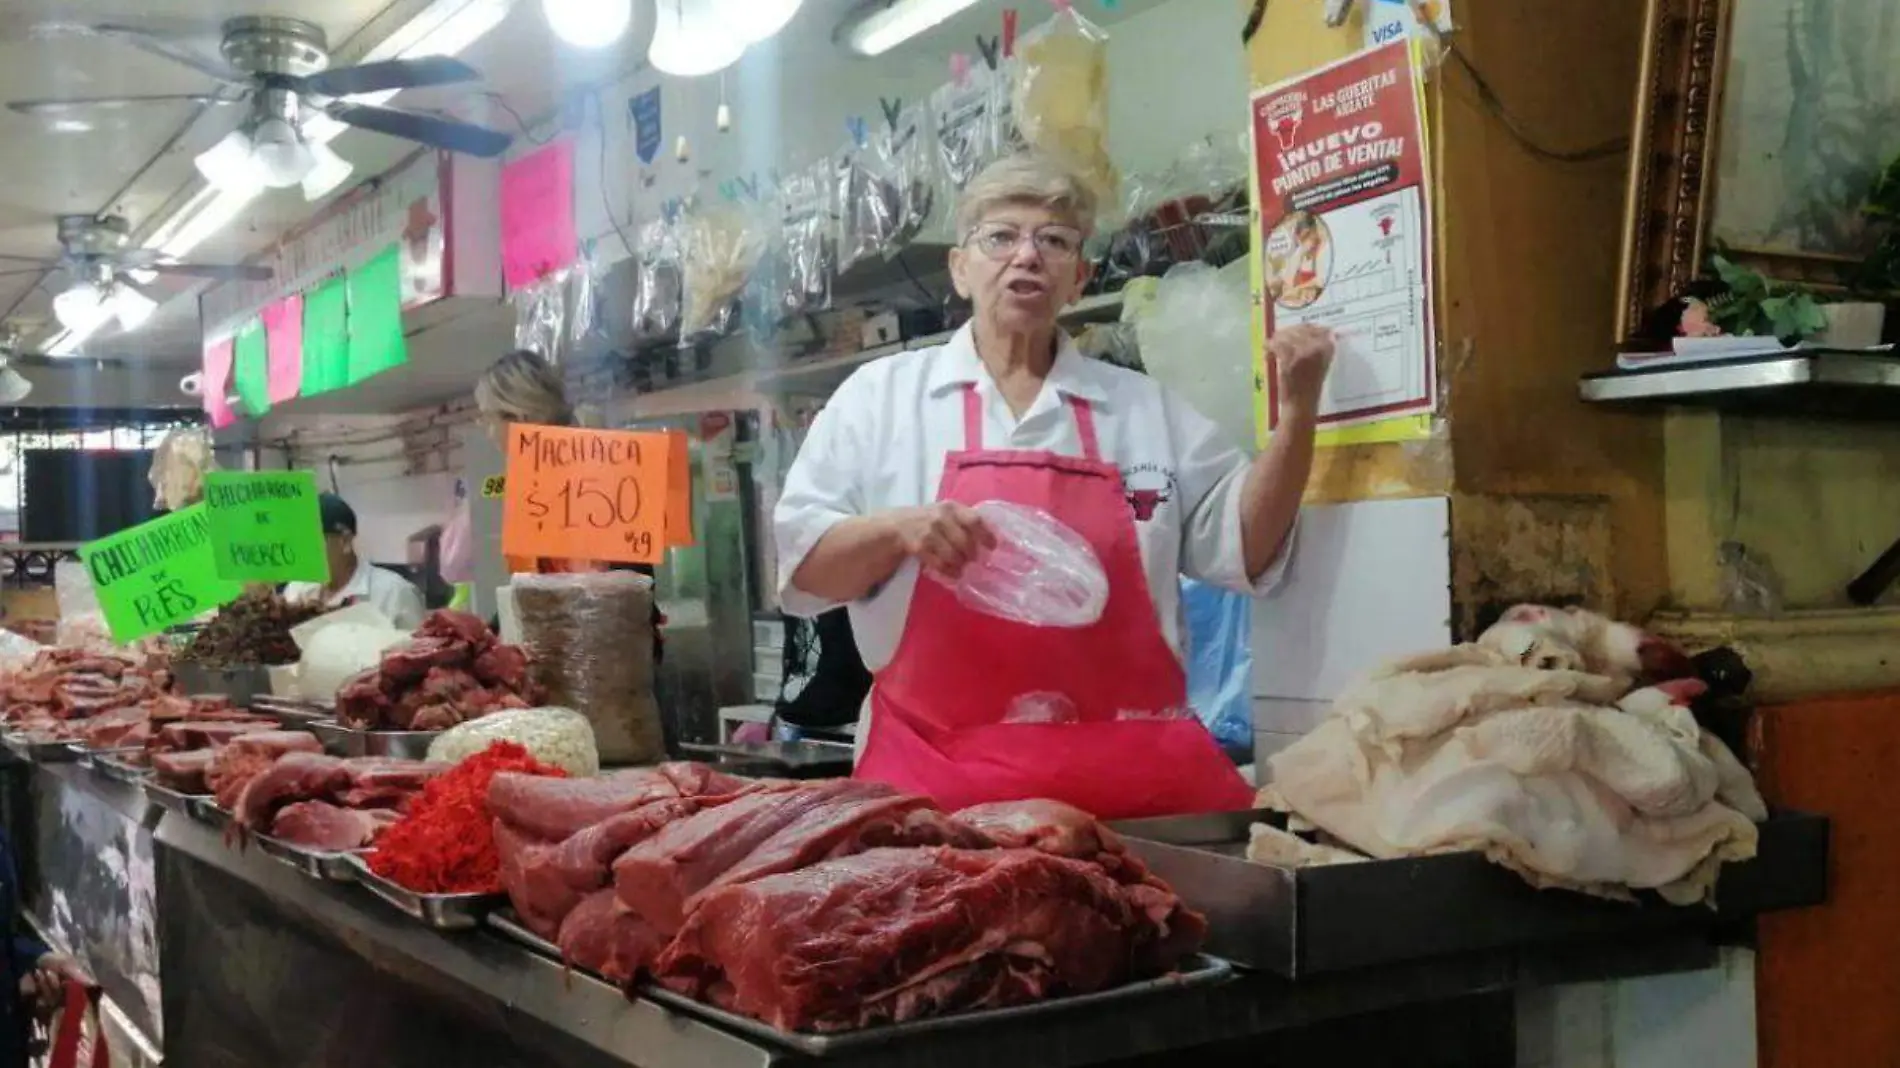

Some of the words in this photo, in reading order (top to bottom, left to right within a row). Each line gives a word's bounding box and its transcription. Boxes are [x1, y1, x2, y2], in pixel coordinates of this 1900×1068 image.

[1372, 20, 1403, 42] VISA
[1312, 92, 1336, 114] LAS
[1272, 158, 1321, 195] PUNTO
[1323, 151, 1344, 174] DE
[1347, 137, 1405, 165] VENTA!
[519, 431, 642, 472] MACHACA
[207, 481, 303, 508] CHICHARRON
[229, 542, 297, 567] PUERCO
